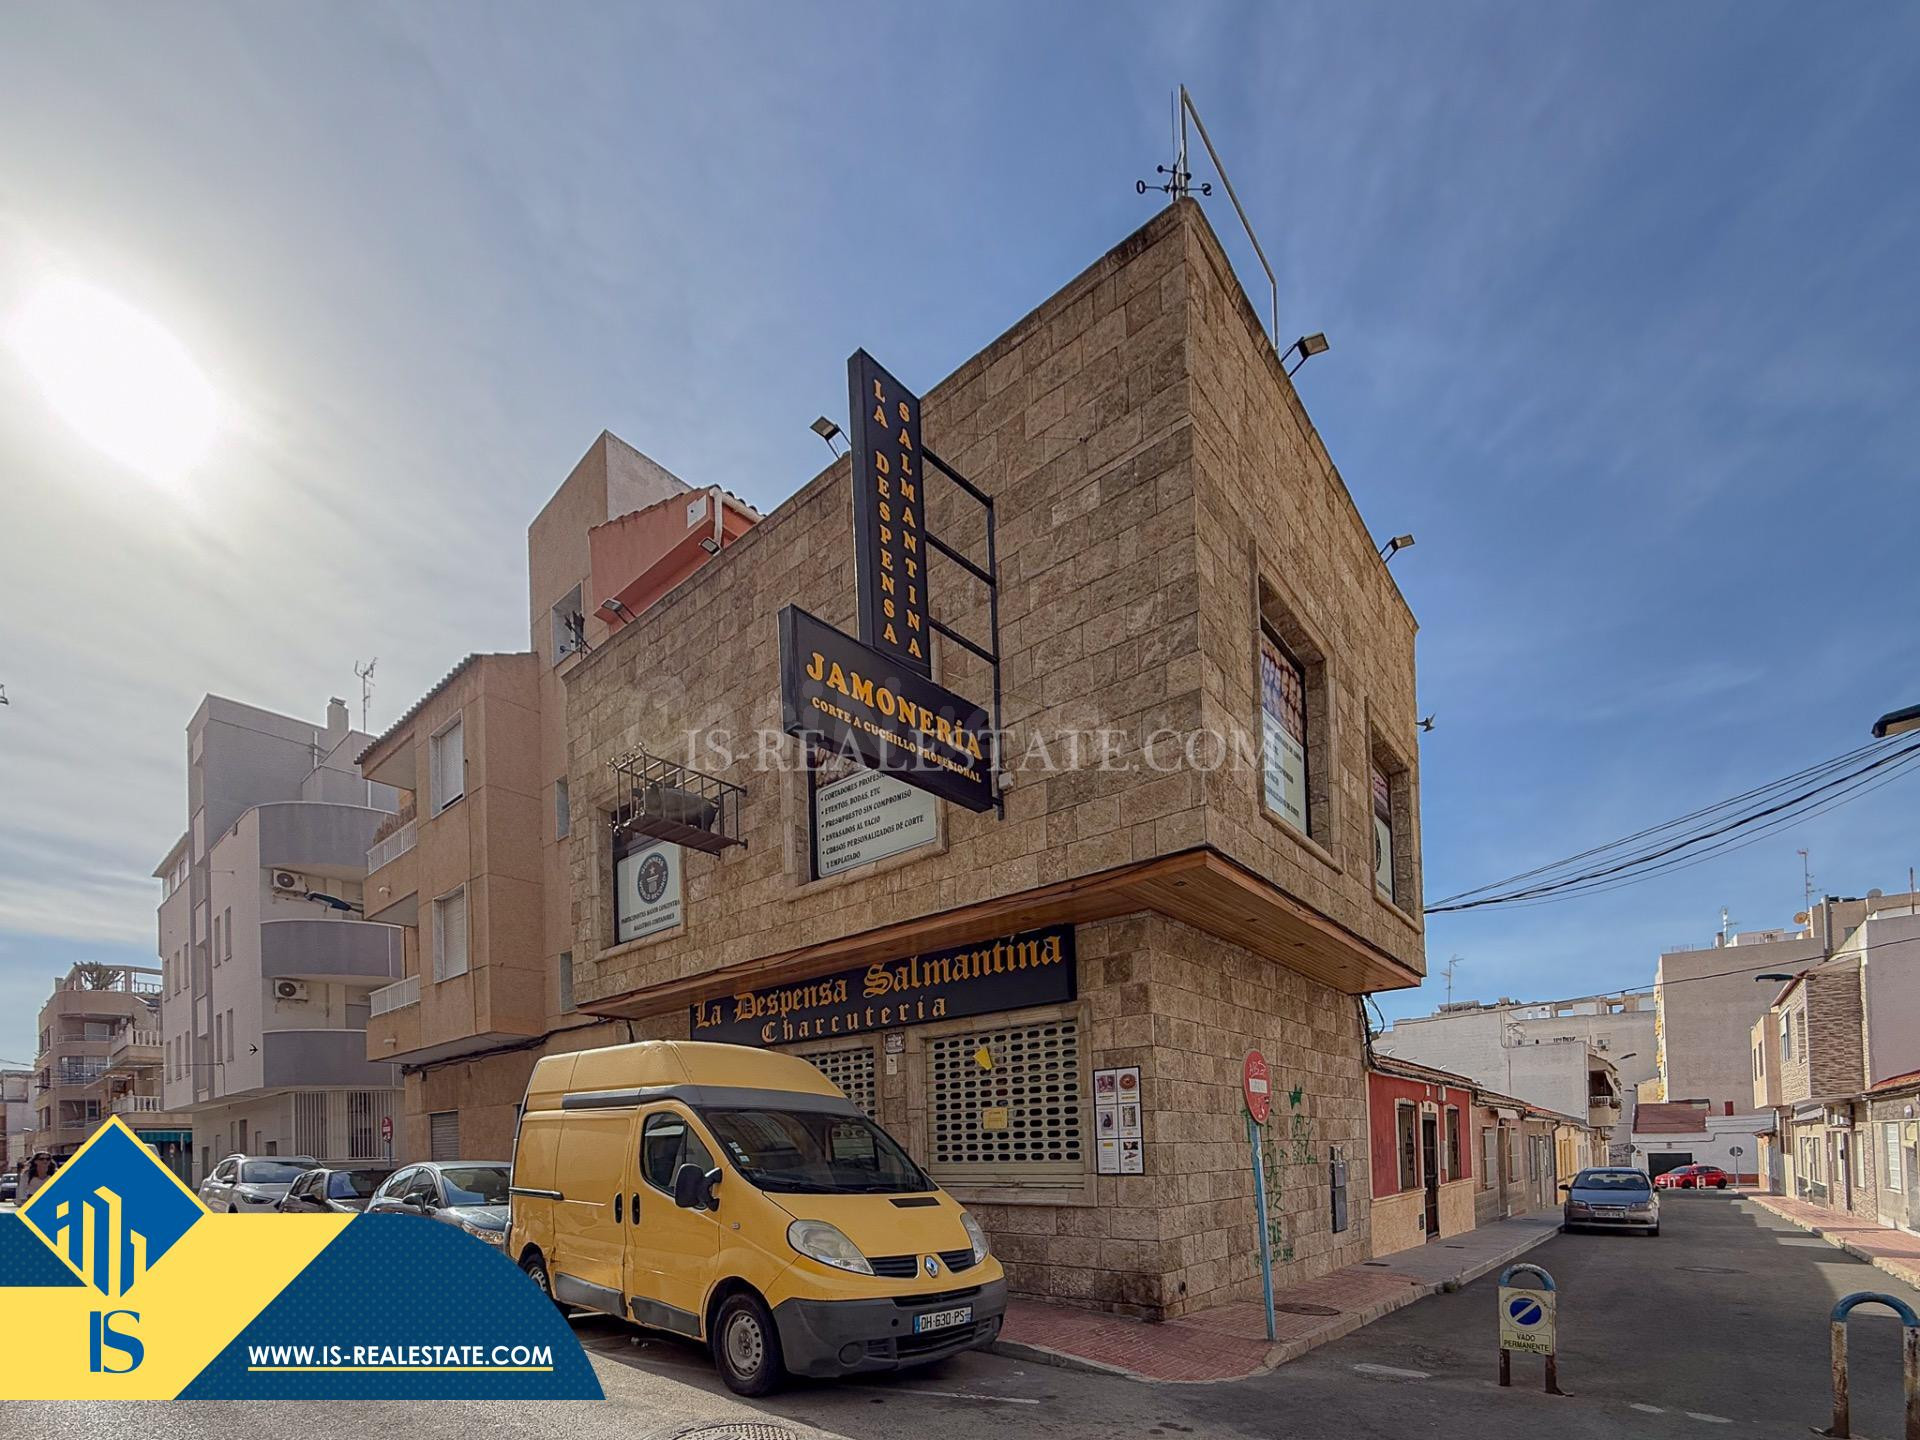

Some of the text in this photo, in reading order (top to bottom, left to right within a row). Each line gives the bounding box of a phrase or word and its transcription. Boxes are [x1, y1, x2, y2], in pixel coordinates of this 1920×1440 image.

[873, 378, 898, 645] LA DESPENSA
[898, 402, 922, 659] SALMANTINA
[811, 696, 982, 784] CORTE A CUCHILLO PROFESIONAL
[824, 782, 858, 802] CORTADORES
[825, 789, 912, 829] PRESUPUESTO SIN COMPROMISO
[846, 824, 895, 849] PERSONALIZADOS
[895, 820, 904, 830] DE
[904, 814, 924, 828] CORTE
[692, 935, 1063, 1029] La Despensa Salmantina
[1503, 1339, 1550, 1352] PERMANENTE
[1516, 1332, 1536, 1342] VADO
